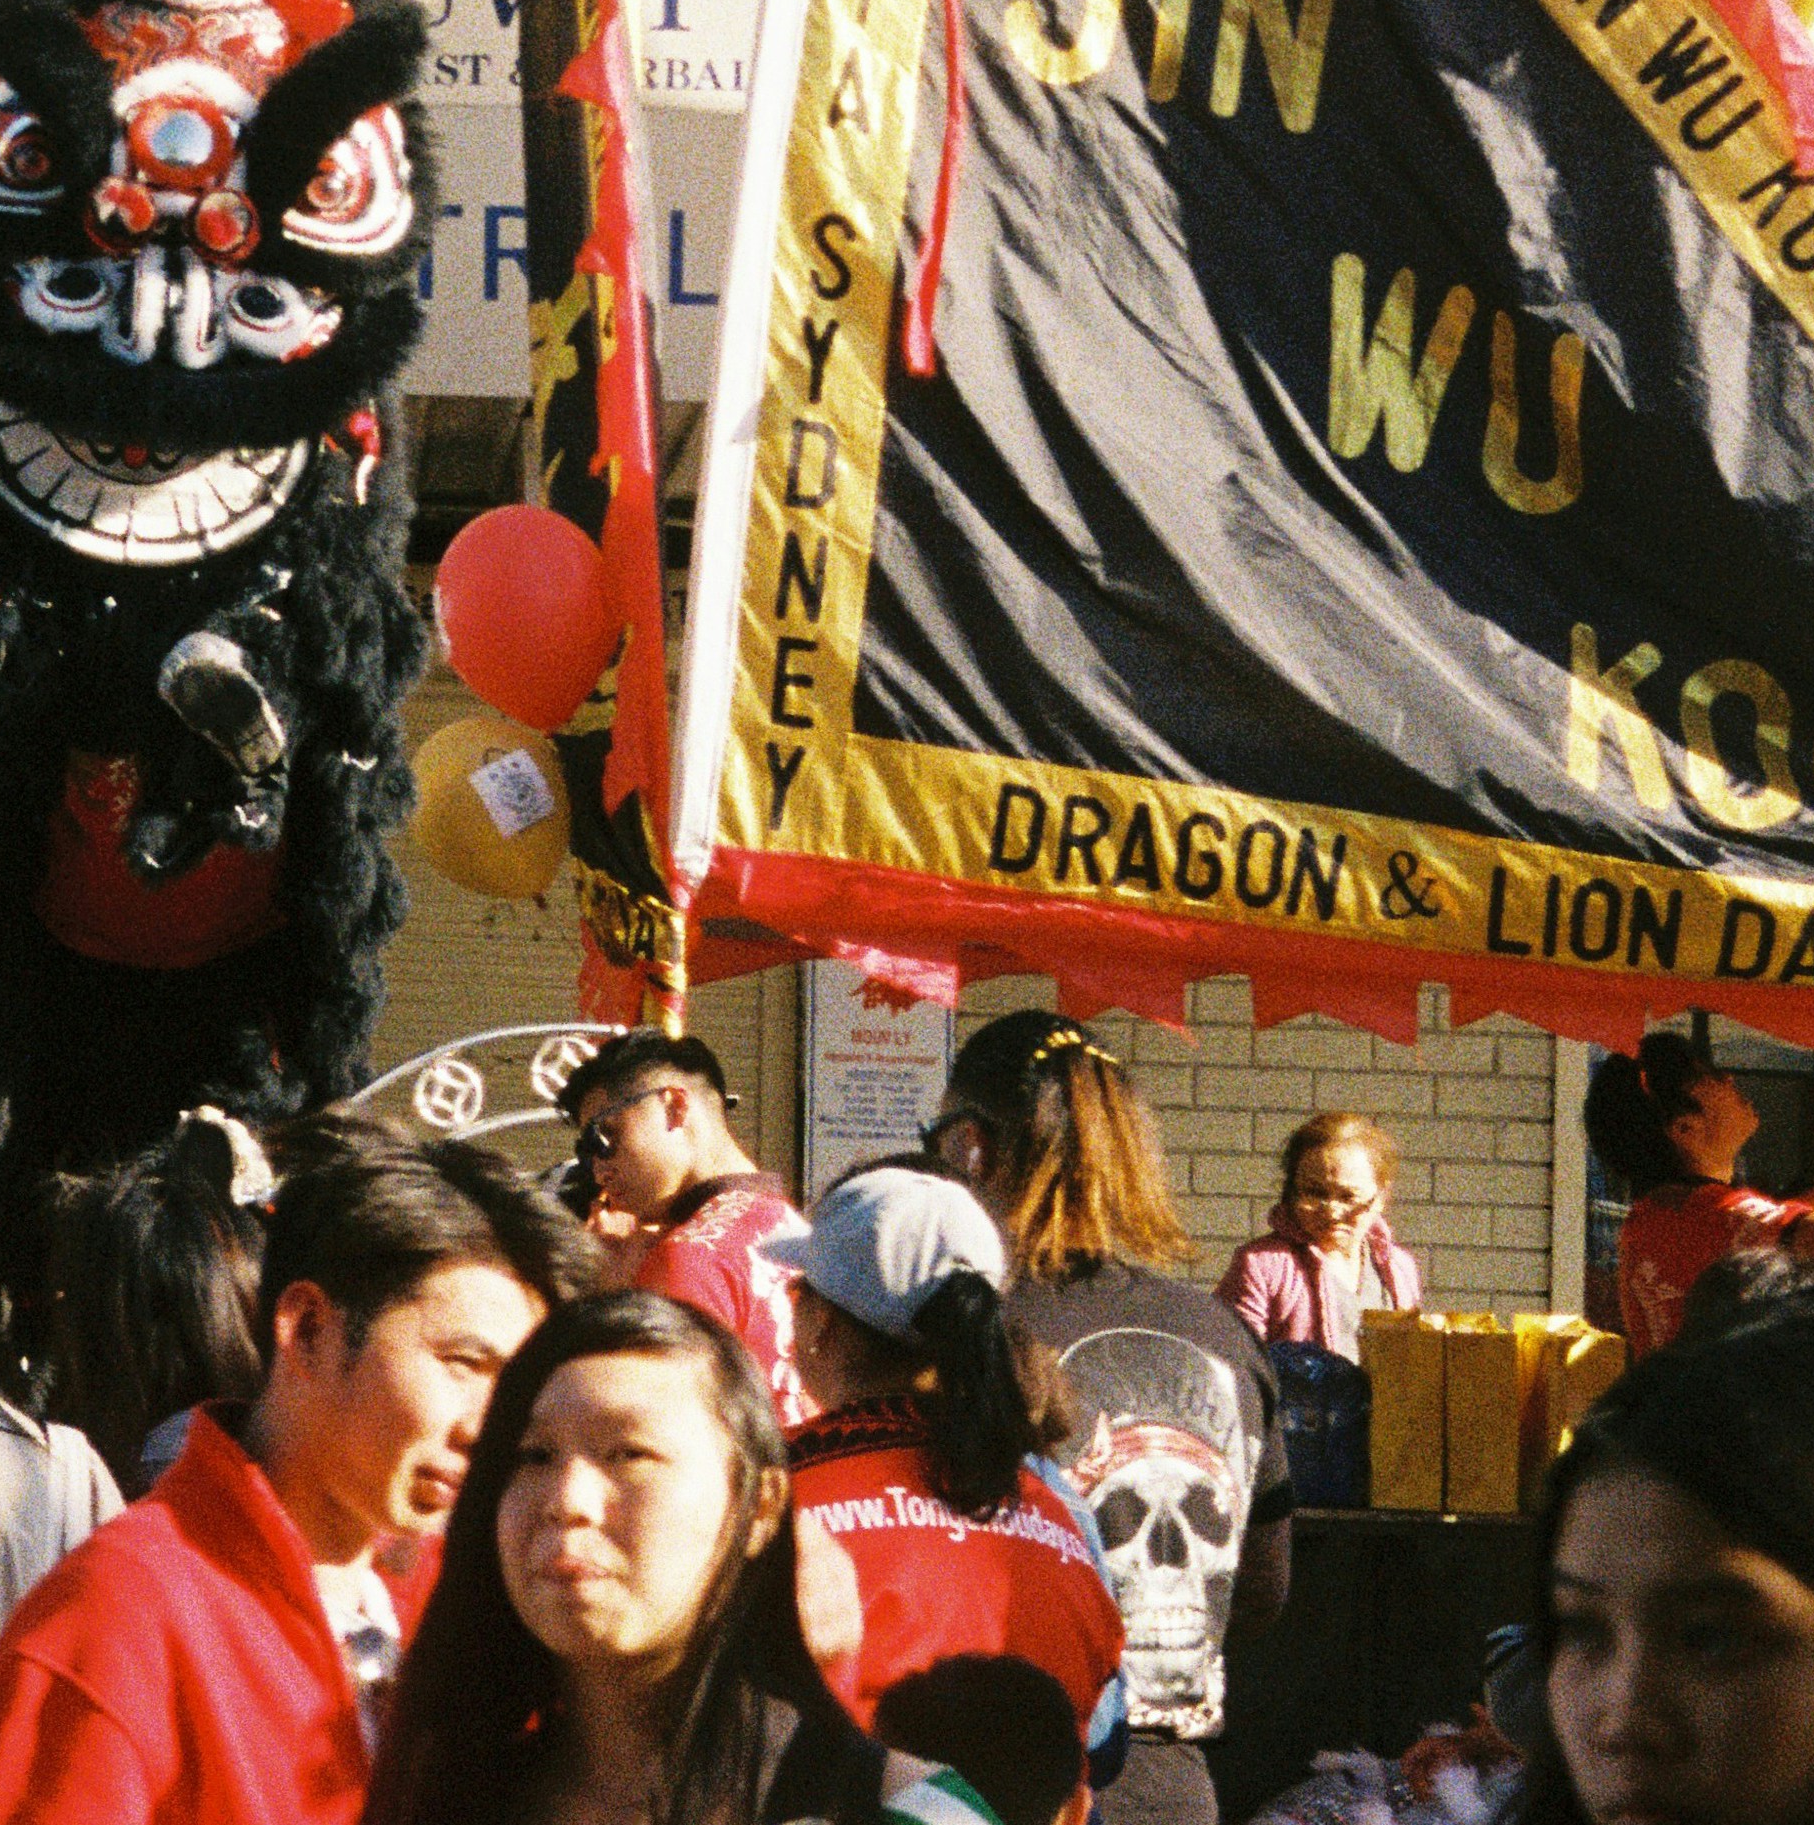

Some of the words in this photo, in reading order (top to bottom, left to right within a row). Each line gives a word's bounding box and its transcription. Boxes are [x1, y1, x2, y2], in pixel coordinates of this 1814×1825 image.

[1328, 251, 1586, 515] WU
[765, 213, 857, 832] SYDNEY
[988, 781, 1348, 922] DRAGON
[1380, 850, 1441, 922] &
[1485, 864, 1683, 972] LION
